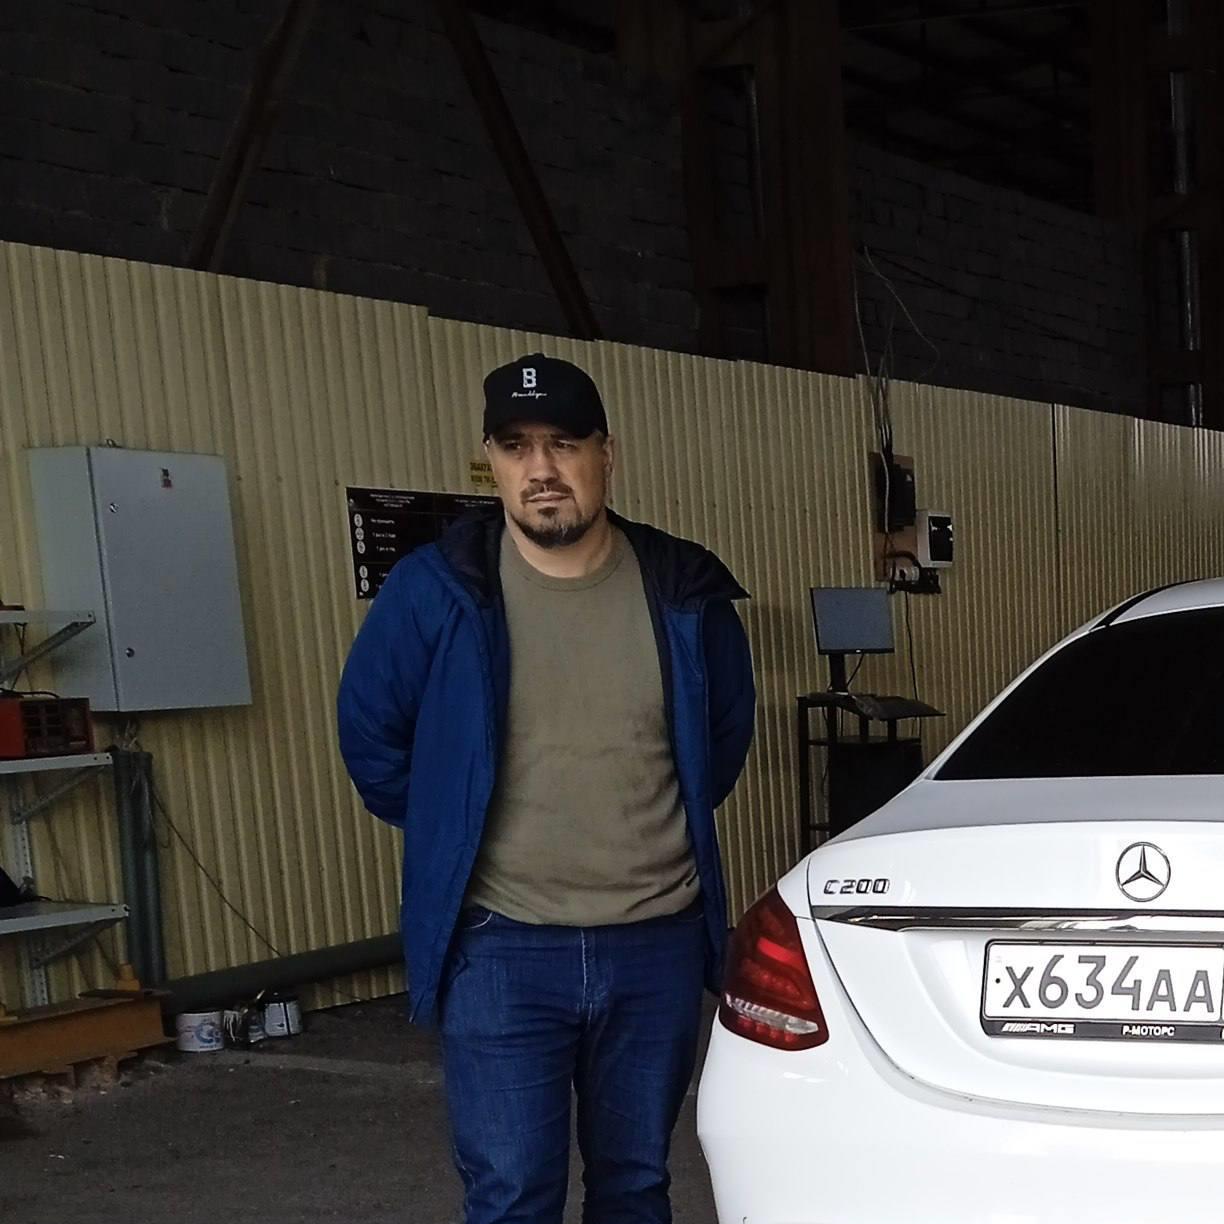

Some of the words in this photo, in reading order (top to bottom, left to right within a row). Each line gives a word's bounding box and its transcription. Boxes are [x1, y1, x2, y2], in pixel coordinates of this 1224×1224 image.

[522, 367, 537, 388] B
[823, 878, 891, 895] C200
[1002, 954, 1215, 1013] Х634АА
